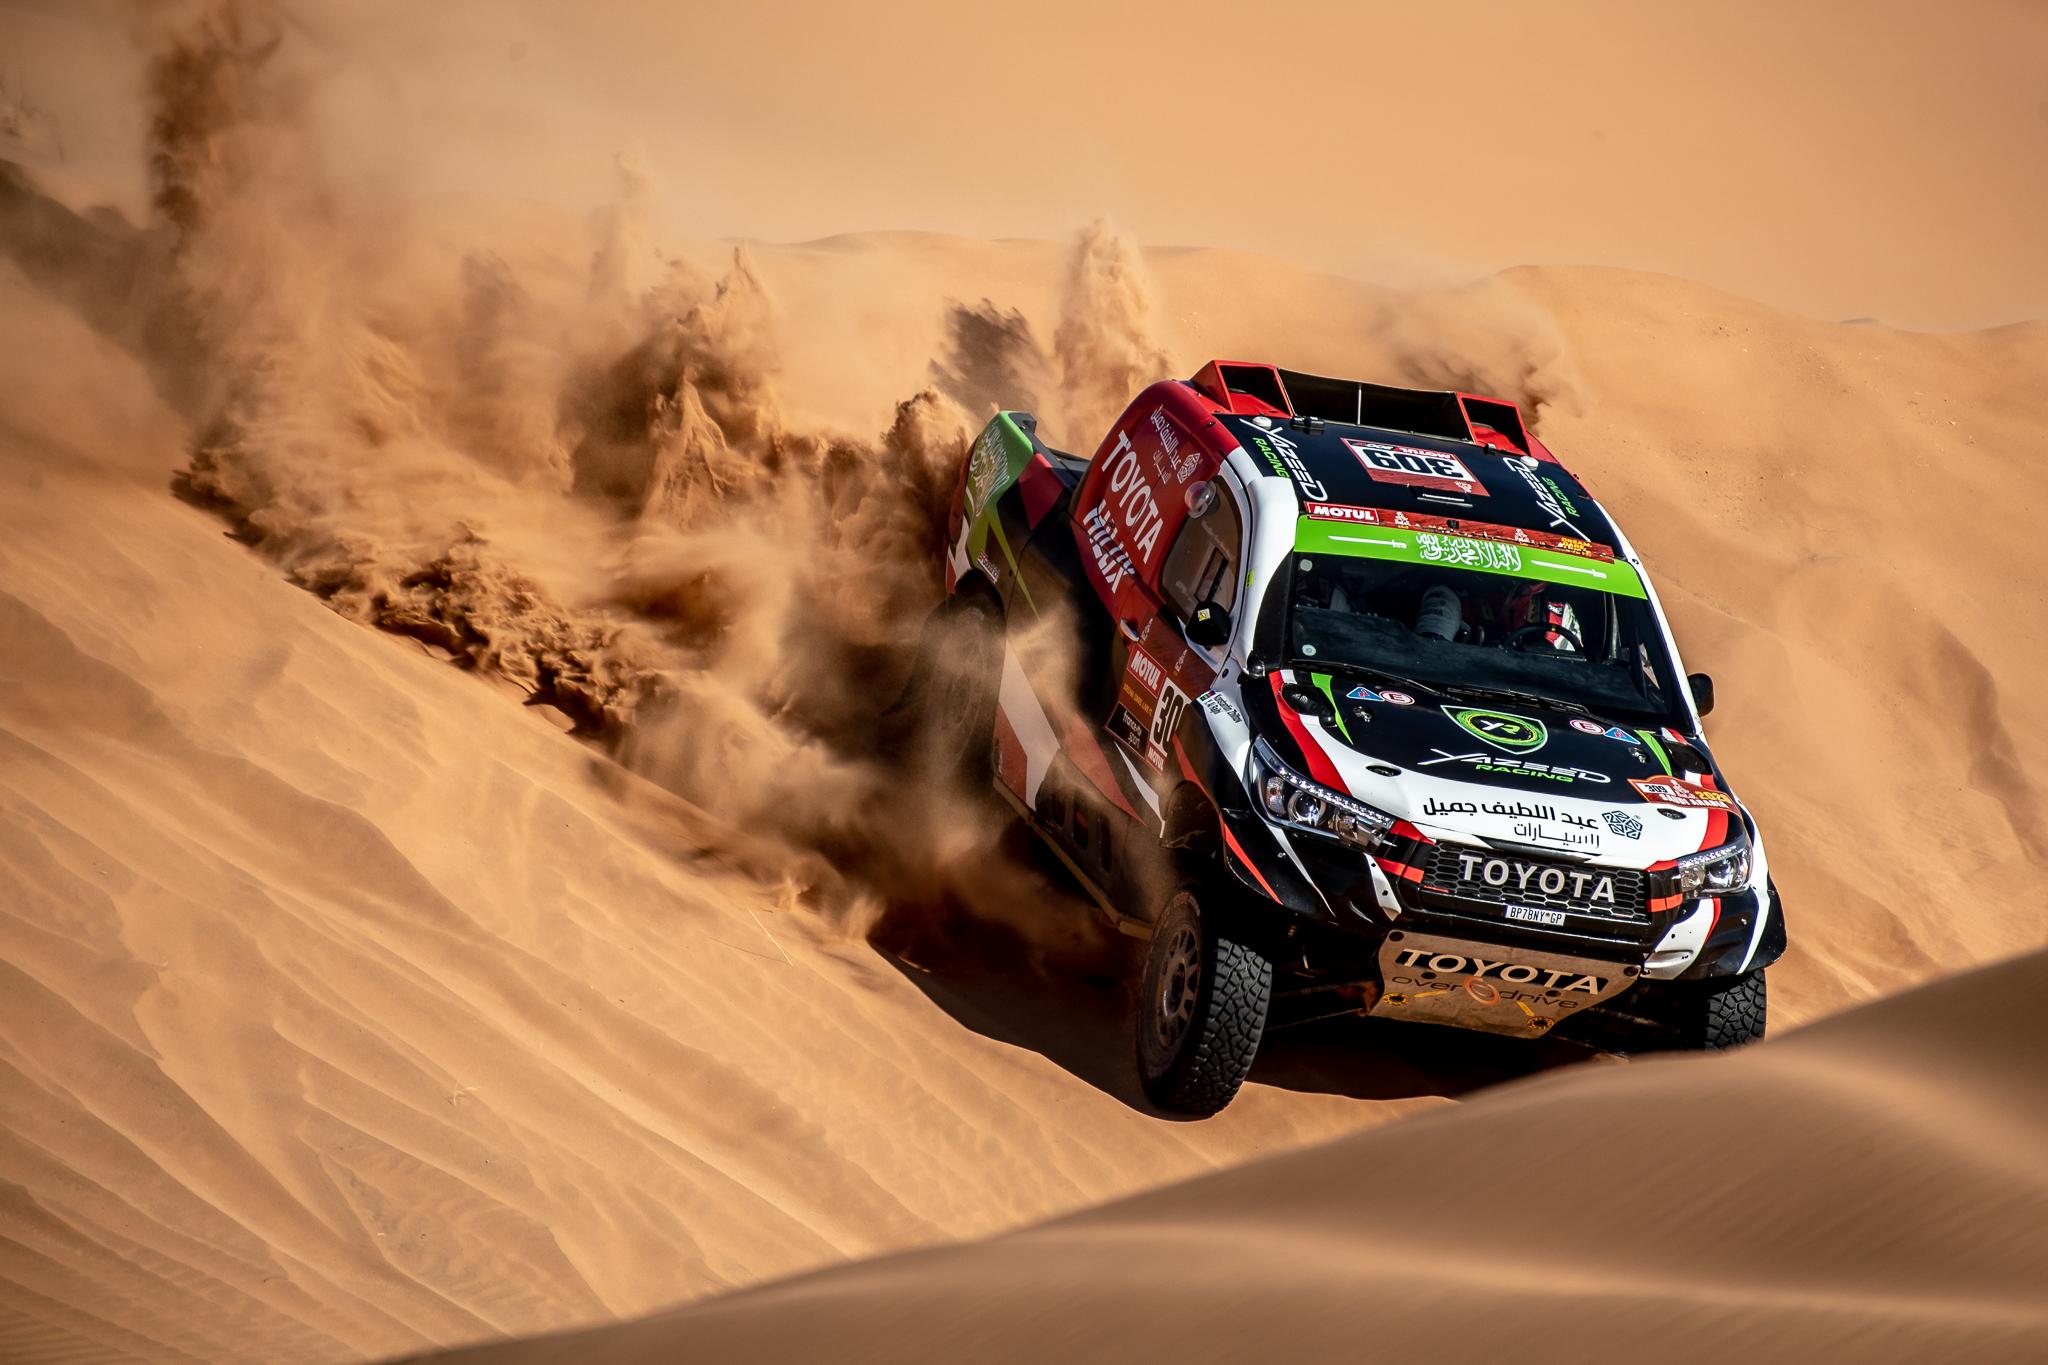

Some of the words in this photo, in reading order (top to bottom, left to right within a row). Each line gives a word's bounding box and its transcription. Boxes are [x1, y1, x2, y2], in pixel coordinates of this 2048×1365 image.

[1239, 418, 1328, 501] YAZEED
[1252, 437, 1290, 478] RACING
[1362, 449, 1464, 478] 309
[1101, 430, 1164, 565] TOYOTA
[1503, 457, 1591, 542] YAZEED
[1313, 506, 1374, 520] MOTUL
[1082, 500, 1136, 594] HILUX
[1131, 650, 1161, 691] MOTUL
[1388, 693, 1405, 701] E
[1579, 722, 1596, 731] E
[1417, 748, 1611, 784] YAZEED
[1475, 764, 1576, 783] RACING
[1423, 797, 1478, 816] جميل
[1645, 784, 1668, 793] 309
[1694, 790, 1733, 804] 2020
[1658, 793, 1690, 805] SAUDI
[1690, 799, 1730, 808] ARABIA
[1481, 801, 1556, 821] اللطيف
[1561, 812, 1599, 830] عبد
[1459, 854, 1616, 903] TOYOTA
[1401, 948, 1600, 996] TOYOTA
